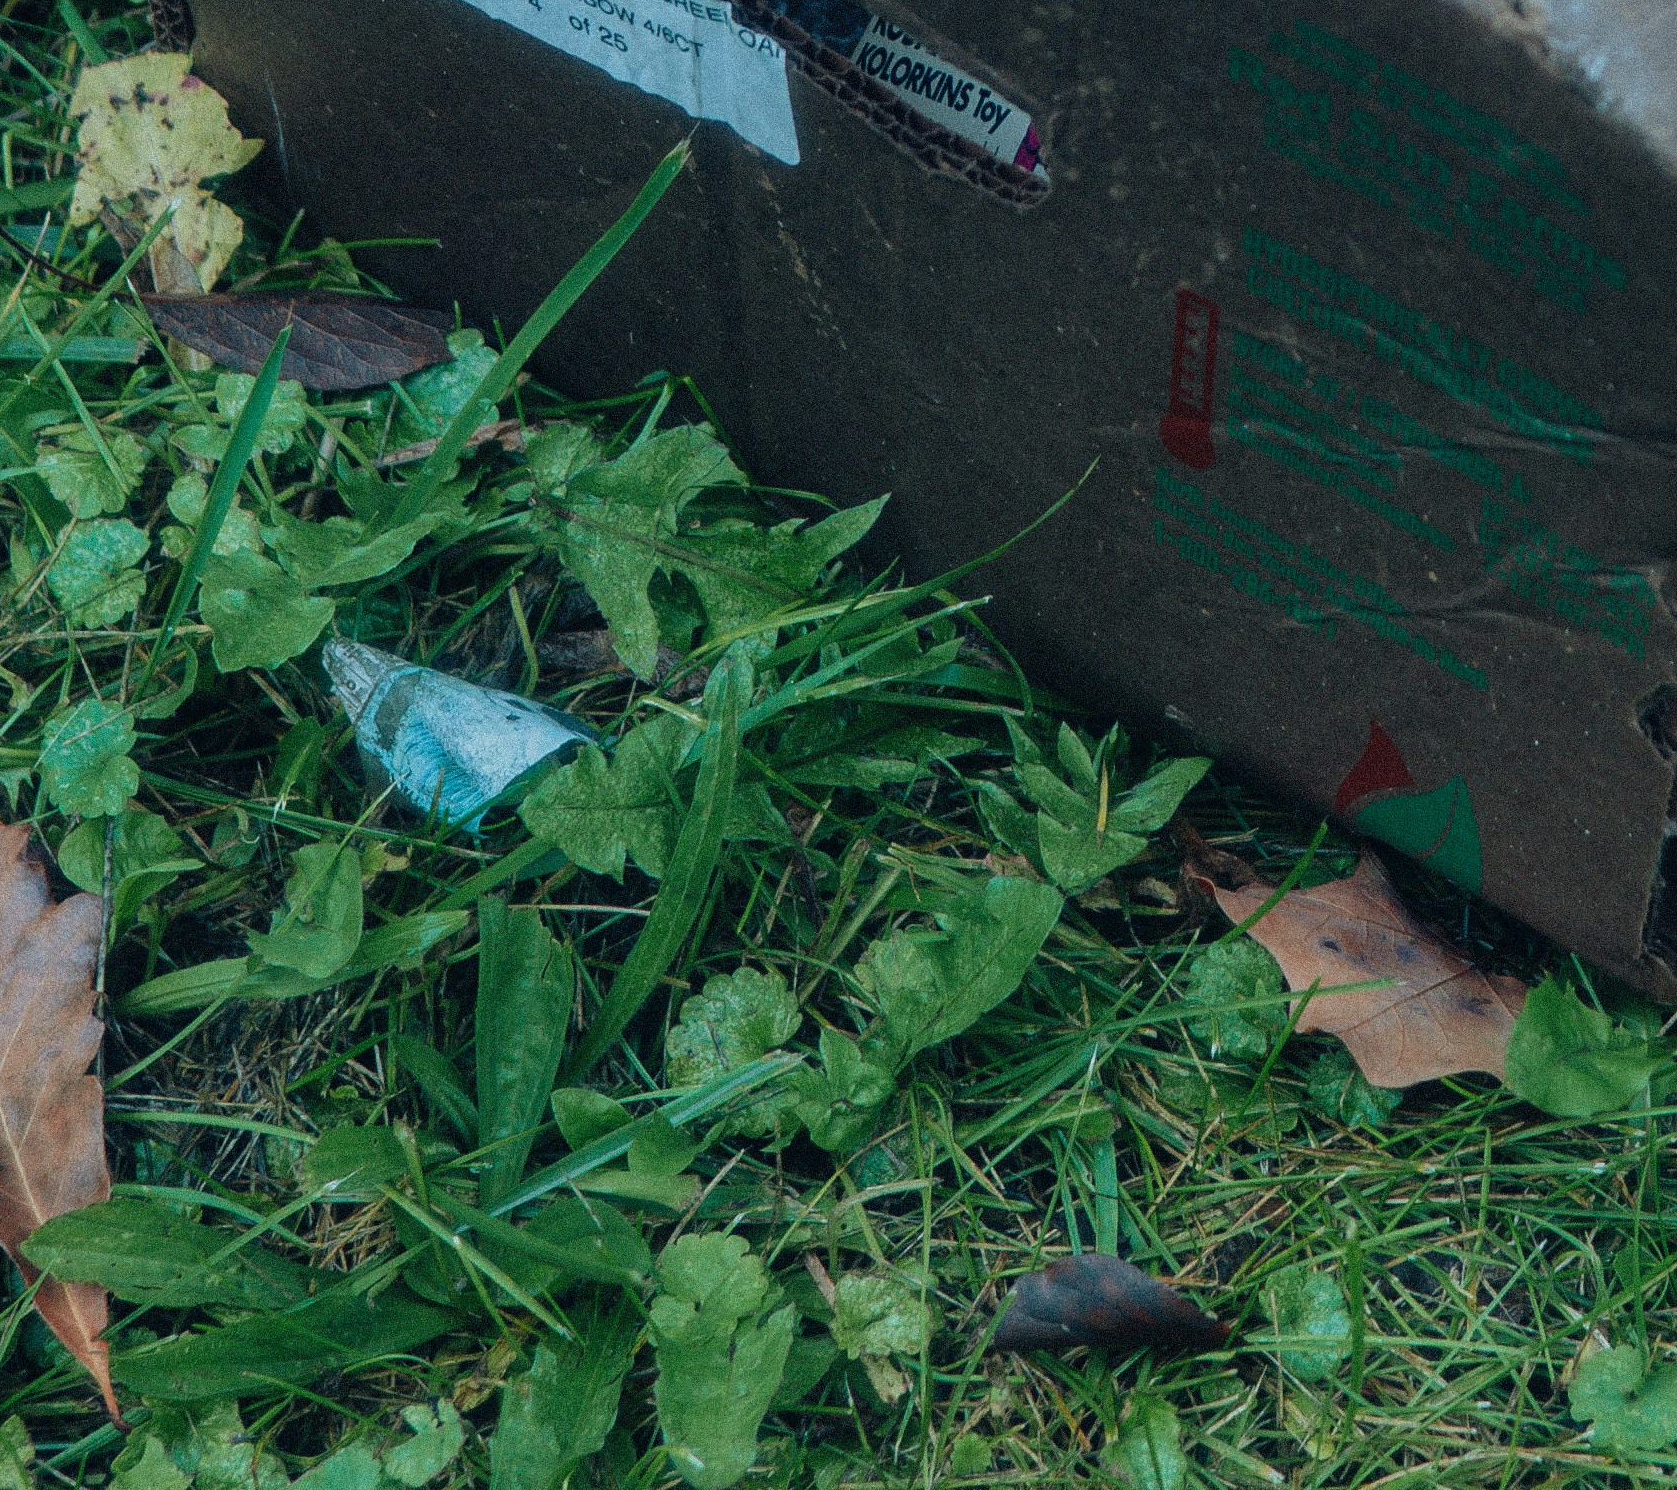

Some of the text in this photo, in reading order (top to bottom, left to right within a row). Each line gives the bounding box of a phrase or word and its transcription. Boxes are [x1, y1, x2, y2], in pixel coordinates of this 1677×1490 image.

[568, 14, 591, 36] of
[598, 24, 629, 53] 25
[855, 41, 1012, 135] KOLORKINS Toy
[1349, 108, 1451, 179] Sun
